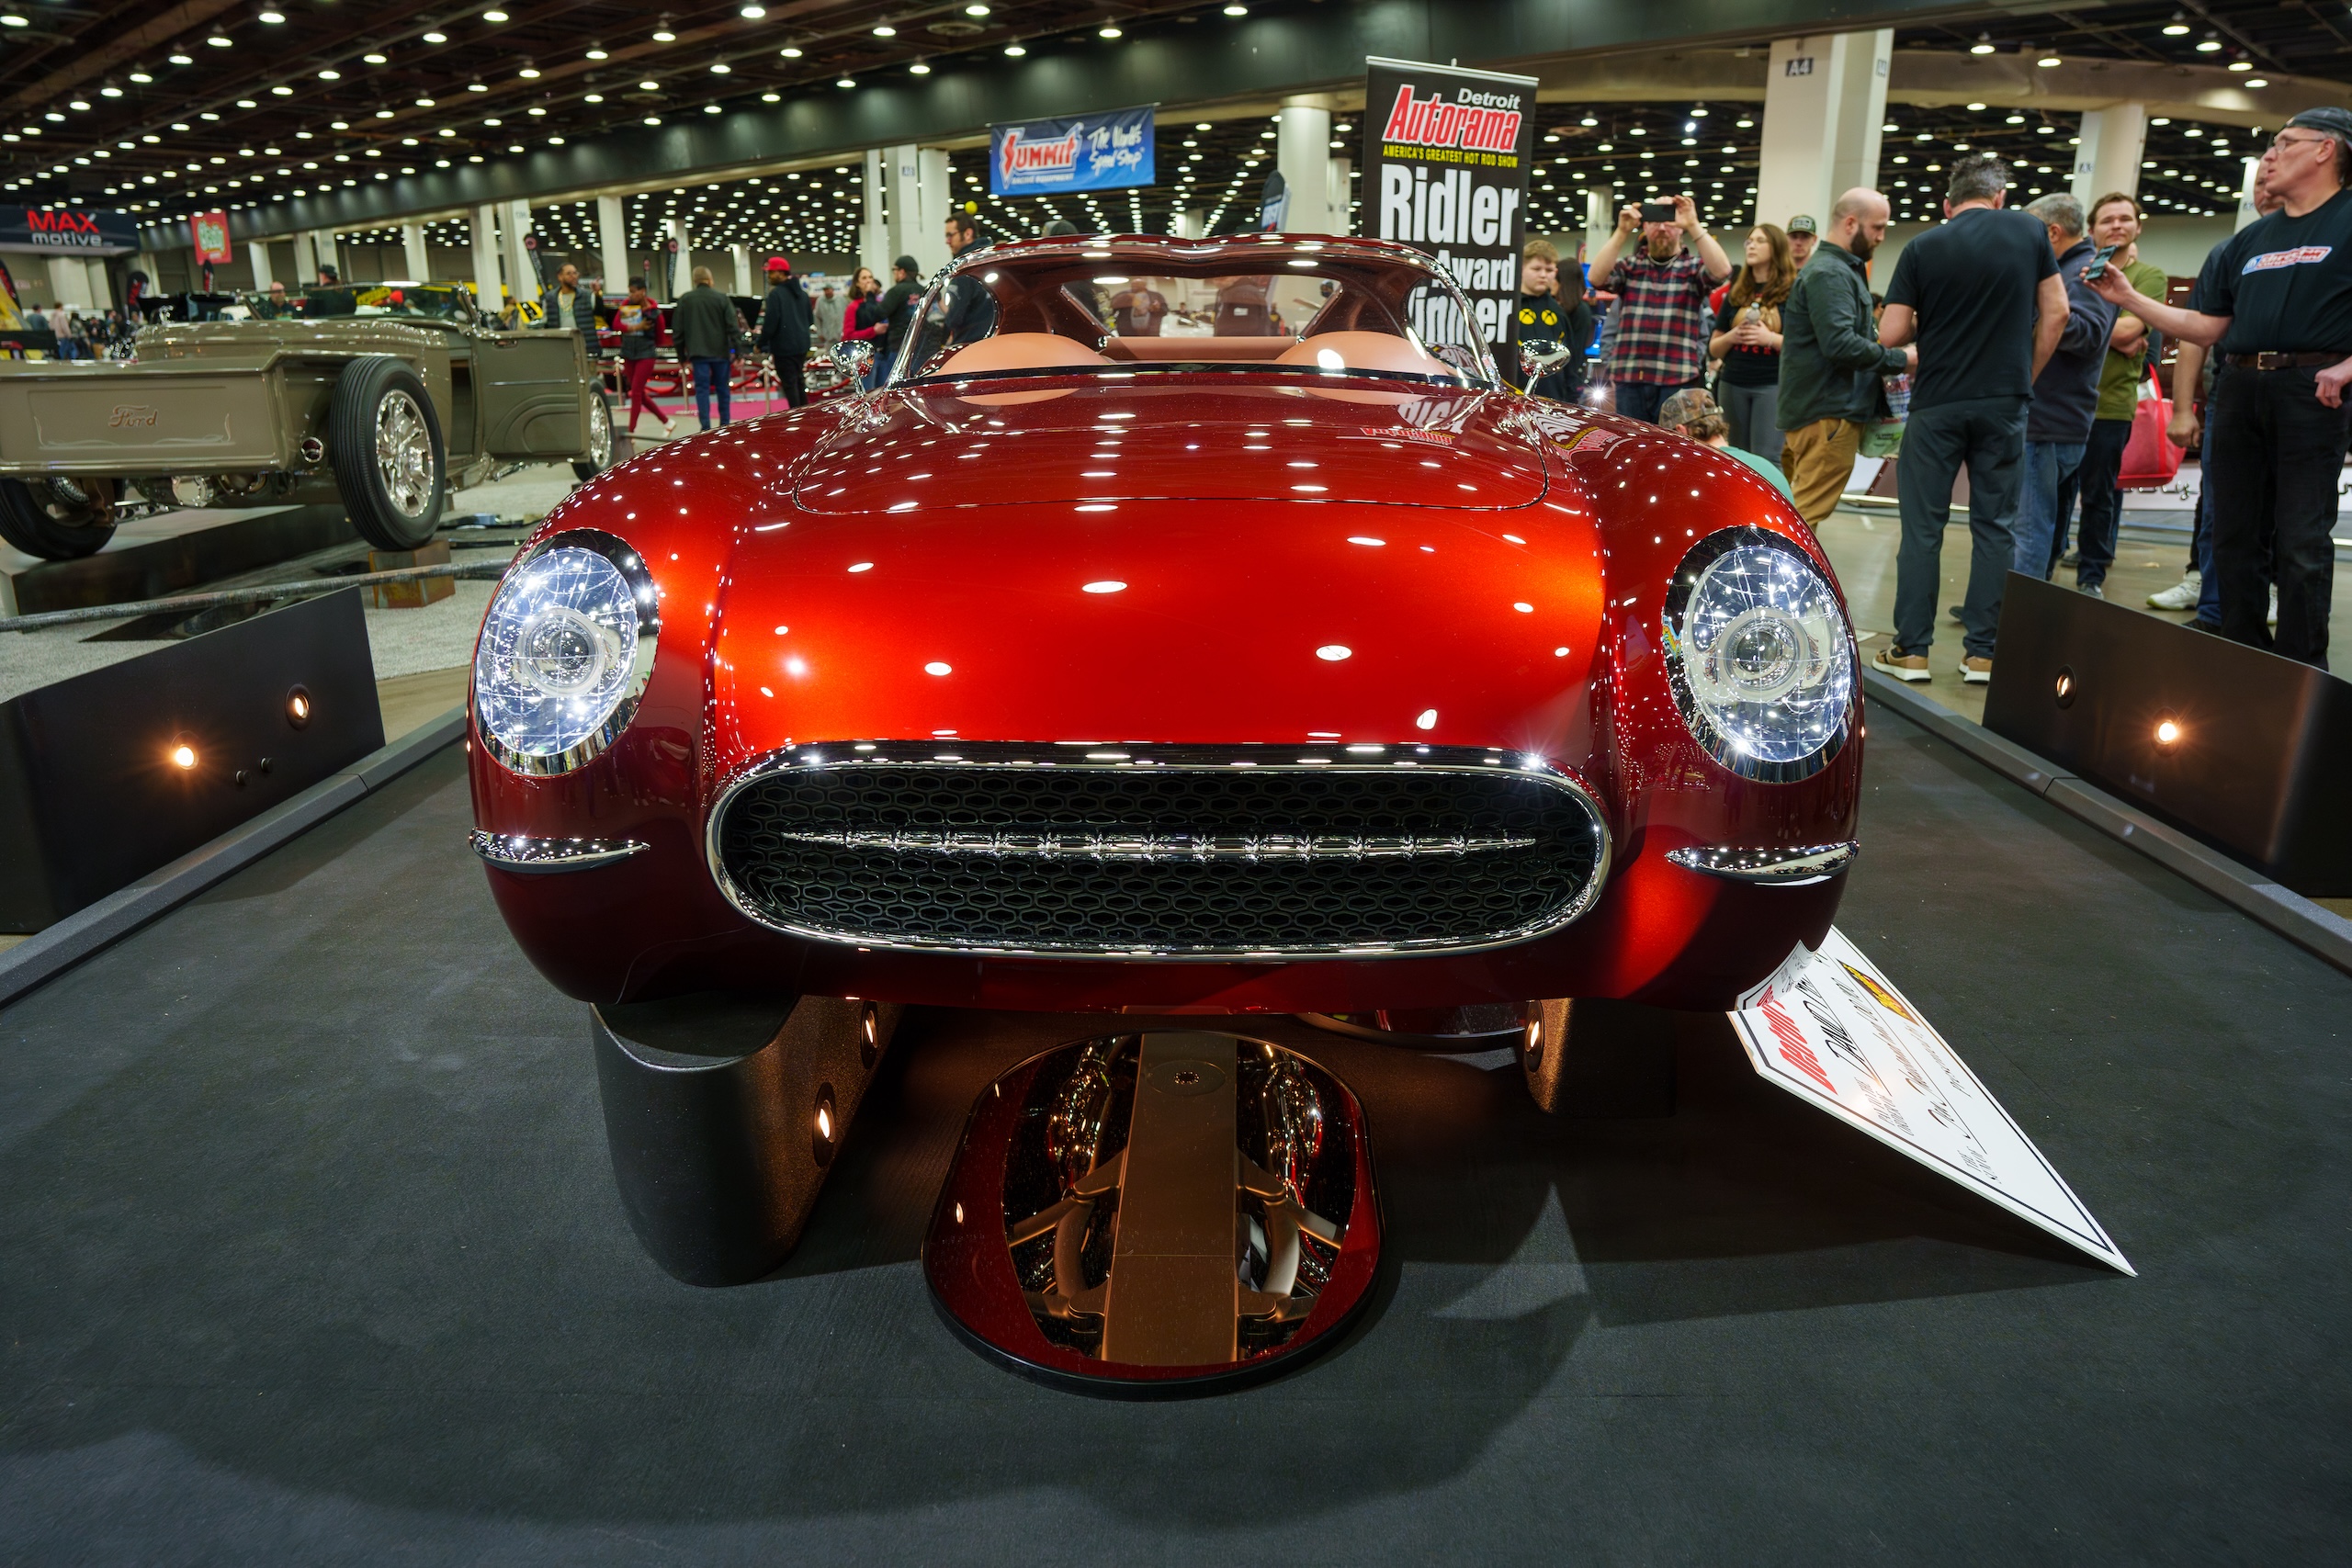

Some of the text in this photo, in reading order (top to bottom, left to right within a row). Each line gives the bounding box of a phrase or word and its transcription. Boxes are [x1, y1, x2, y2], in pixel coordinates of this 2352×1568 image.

[1787, 59, 1811, 75] A4
[1457, 87, 1521, 109] Detroit
[1382, 85, 1522, 152] Autorama
[1087, 126, 1111, 152] The
[1089, 147, 1143, 176] Speed Shop
[1383, 144, 1519, 168] AMERICA'S GREATEST HOT ROD SHOW
[1380, 163, 1520, 246] Ridler
[27, 209, 99, 233] MAX
[31, 231, 102, 247] motive
[108, 404, 158, 427] Ford
